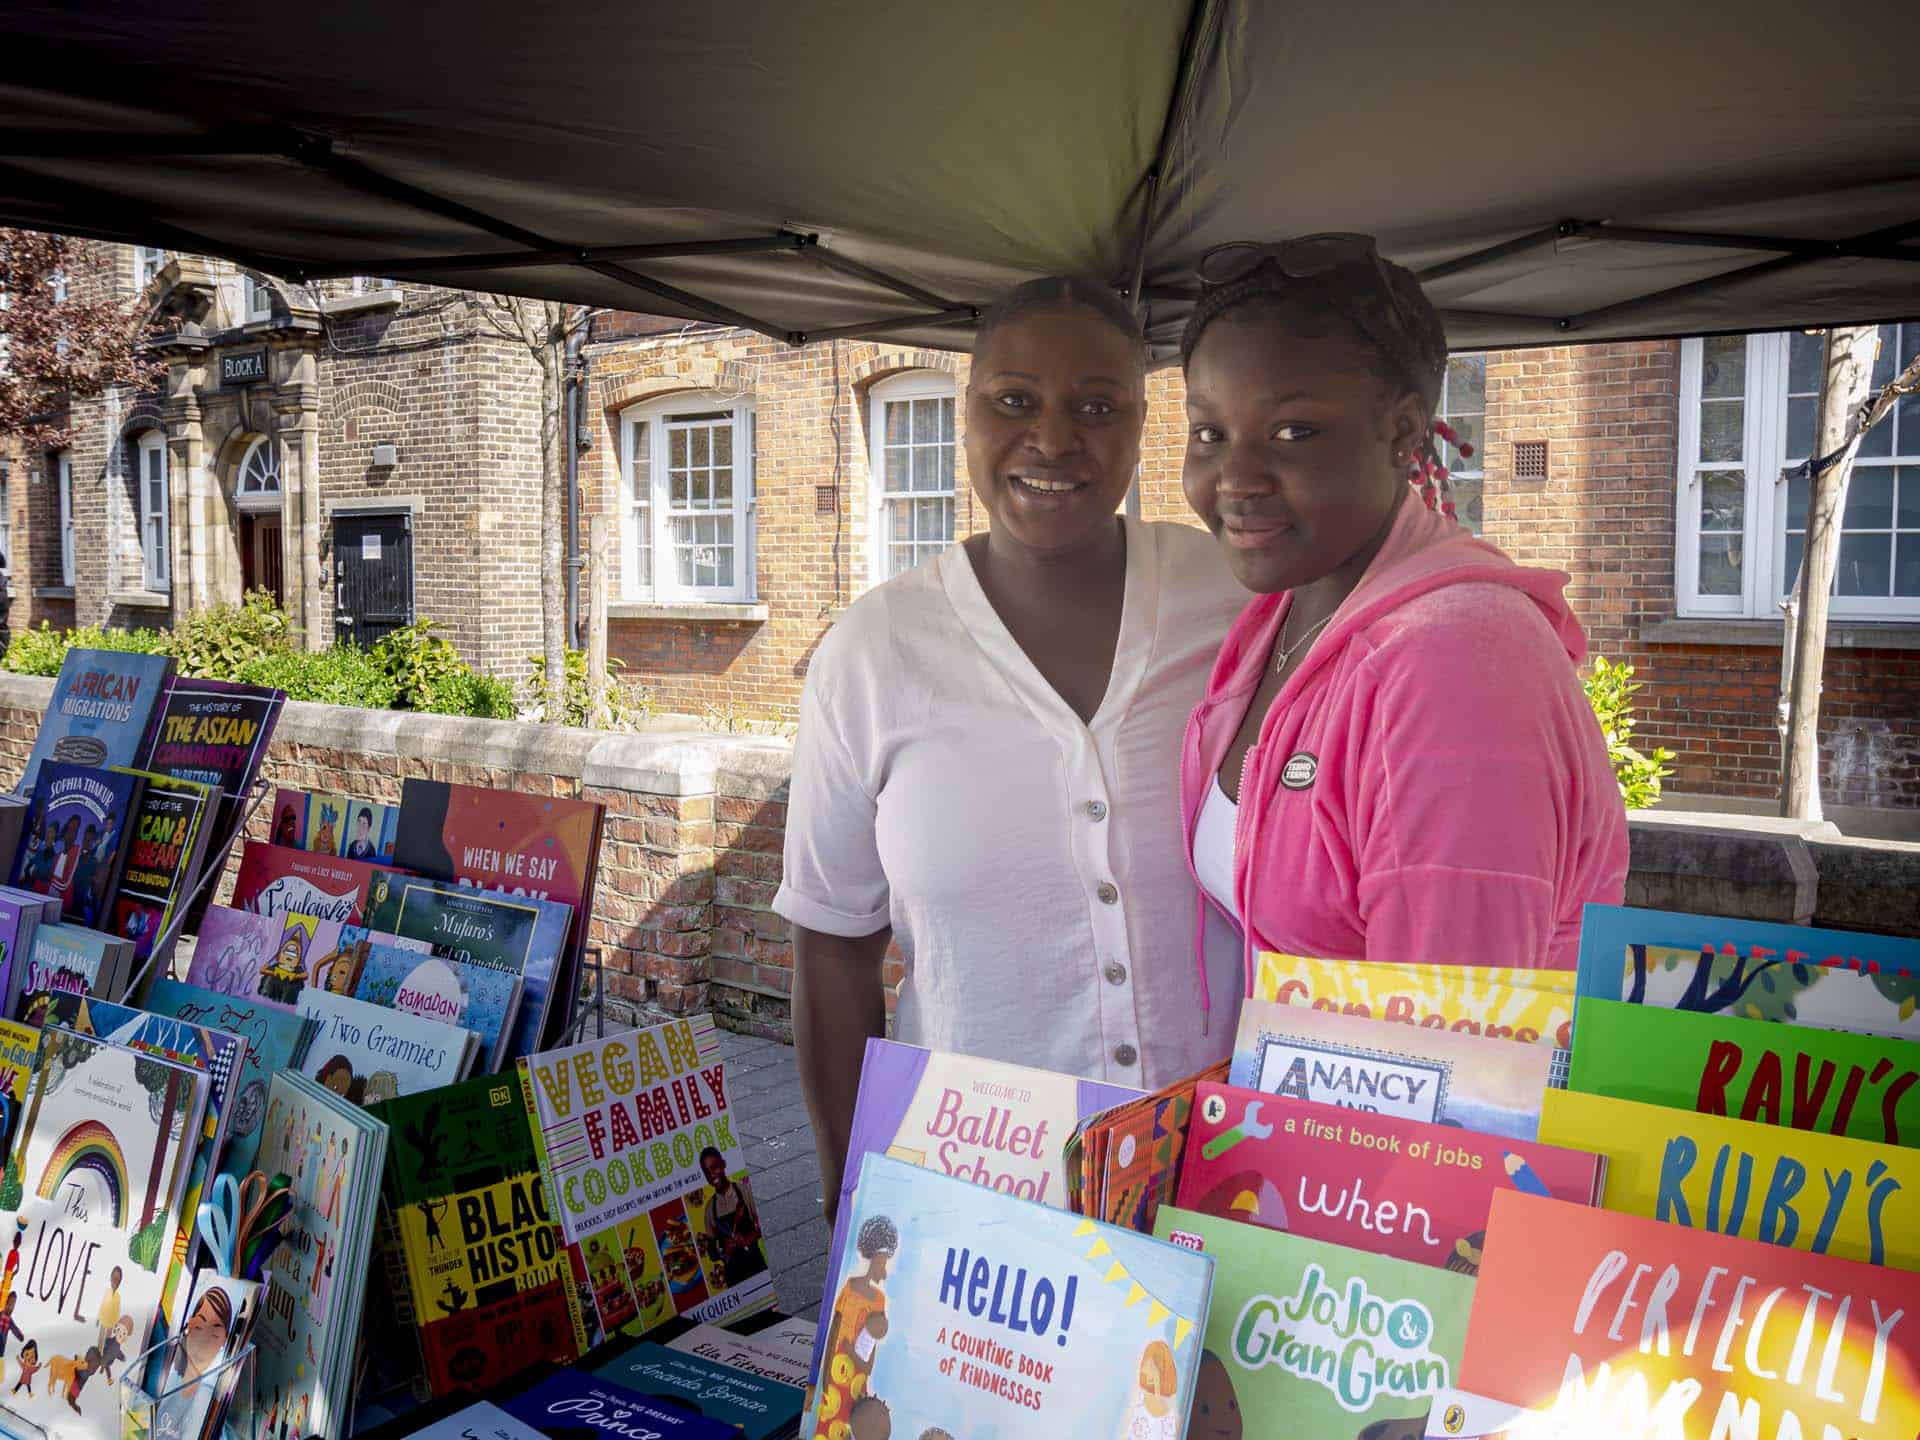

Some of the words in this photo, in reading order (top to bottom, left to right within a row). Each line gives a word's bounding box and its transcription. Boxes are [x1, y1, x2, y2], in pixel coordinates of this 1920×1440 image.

[225, 358, 253, 378] BLOCK
[61, 697, 133, 723] MIGRATIONS
[68, 671, 141, 702] AFRICAN
[188, 703, 201, 712] THE
[156, 744, 248, 769] COMMUNITY
[165, 715, 196, 744] THE
[194, 716, 257, 746] ASIAN
[50, 777, 82, 799] SOPHIA
[83, 777, 115, 807] THAKUR
[463, 846, 500, 873] WHEN
[504, 852, 523, 877] WE
[529, 856, 558, 881] SAY
[433, 912, 495, 943] Mufaro's
[306, 1006, 325, 1041] My
[331, 1014, 360, 1046] Two
[367, 1024, 448, 1072] Grannies
[491, 1088, 509, 1103] DK
[536, 1019, 701, 1118] VEGAN
[1275, 1057, 1427, 1106] ANANCY
[1695, 1040, 1920, 1146] RAVI'S
[583, 1064, 727, 1161] FAMILY
[926, 1088, 1049, 1160] Ballet
[563, 1114, 737, 1213] COOKBOOK
[1284, 1120, 1297, 1134] a
[1302, 1117, 1343, 1144] first
[1349, 1127, 1401, 1154] book
[1408, 1140, 1431, 1160] of
[1434, 1144, 1484, 1171] jobs
[939, 1140, 1051, 1203] School
[66, 1182, 89, 1223] This
[457, 1175, 549, 1245] BLAC
[1298, 1175, 1440, 1246] when
[1656, 1135, 1903, 1267] RUBY'S
[26, 1220, 102, 1323] LOVE
[466, 1225, 556, 1286] HISTO
[1284, 1268, 1385, 1340] JoJo
[692, 1343, 721, 1359] Ella
[782, 1357, 809, 1369] DREAM
[936, 1327, 946, 1344] A
[1018, 1353, 1054, 1384] BOOK
[1235, 1300, 1446, 1407] GranGran
[1573, 1250, 1905, 1424] PERFECTLY
[630, 1363, 702, 1391] Amanda
[547, 1399, 662, 1440] Prince
